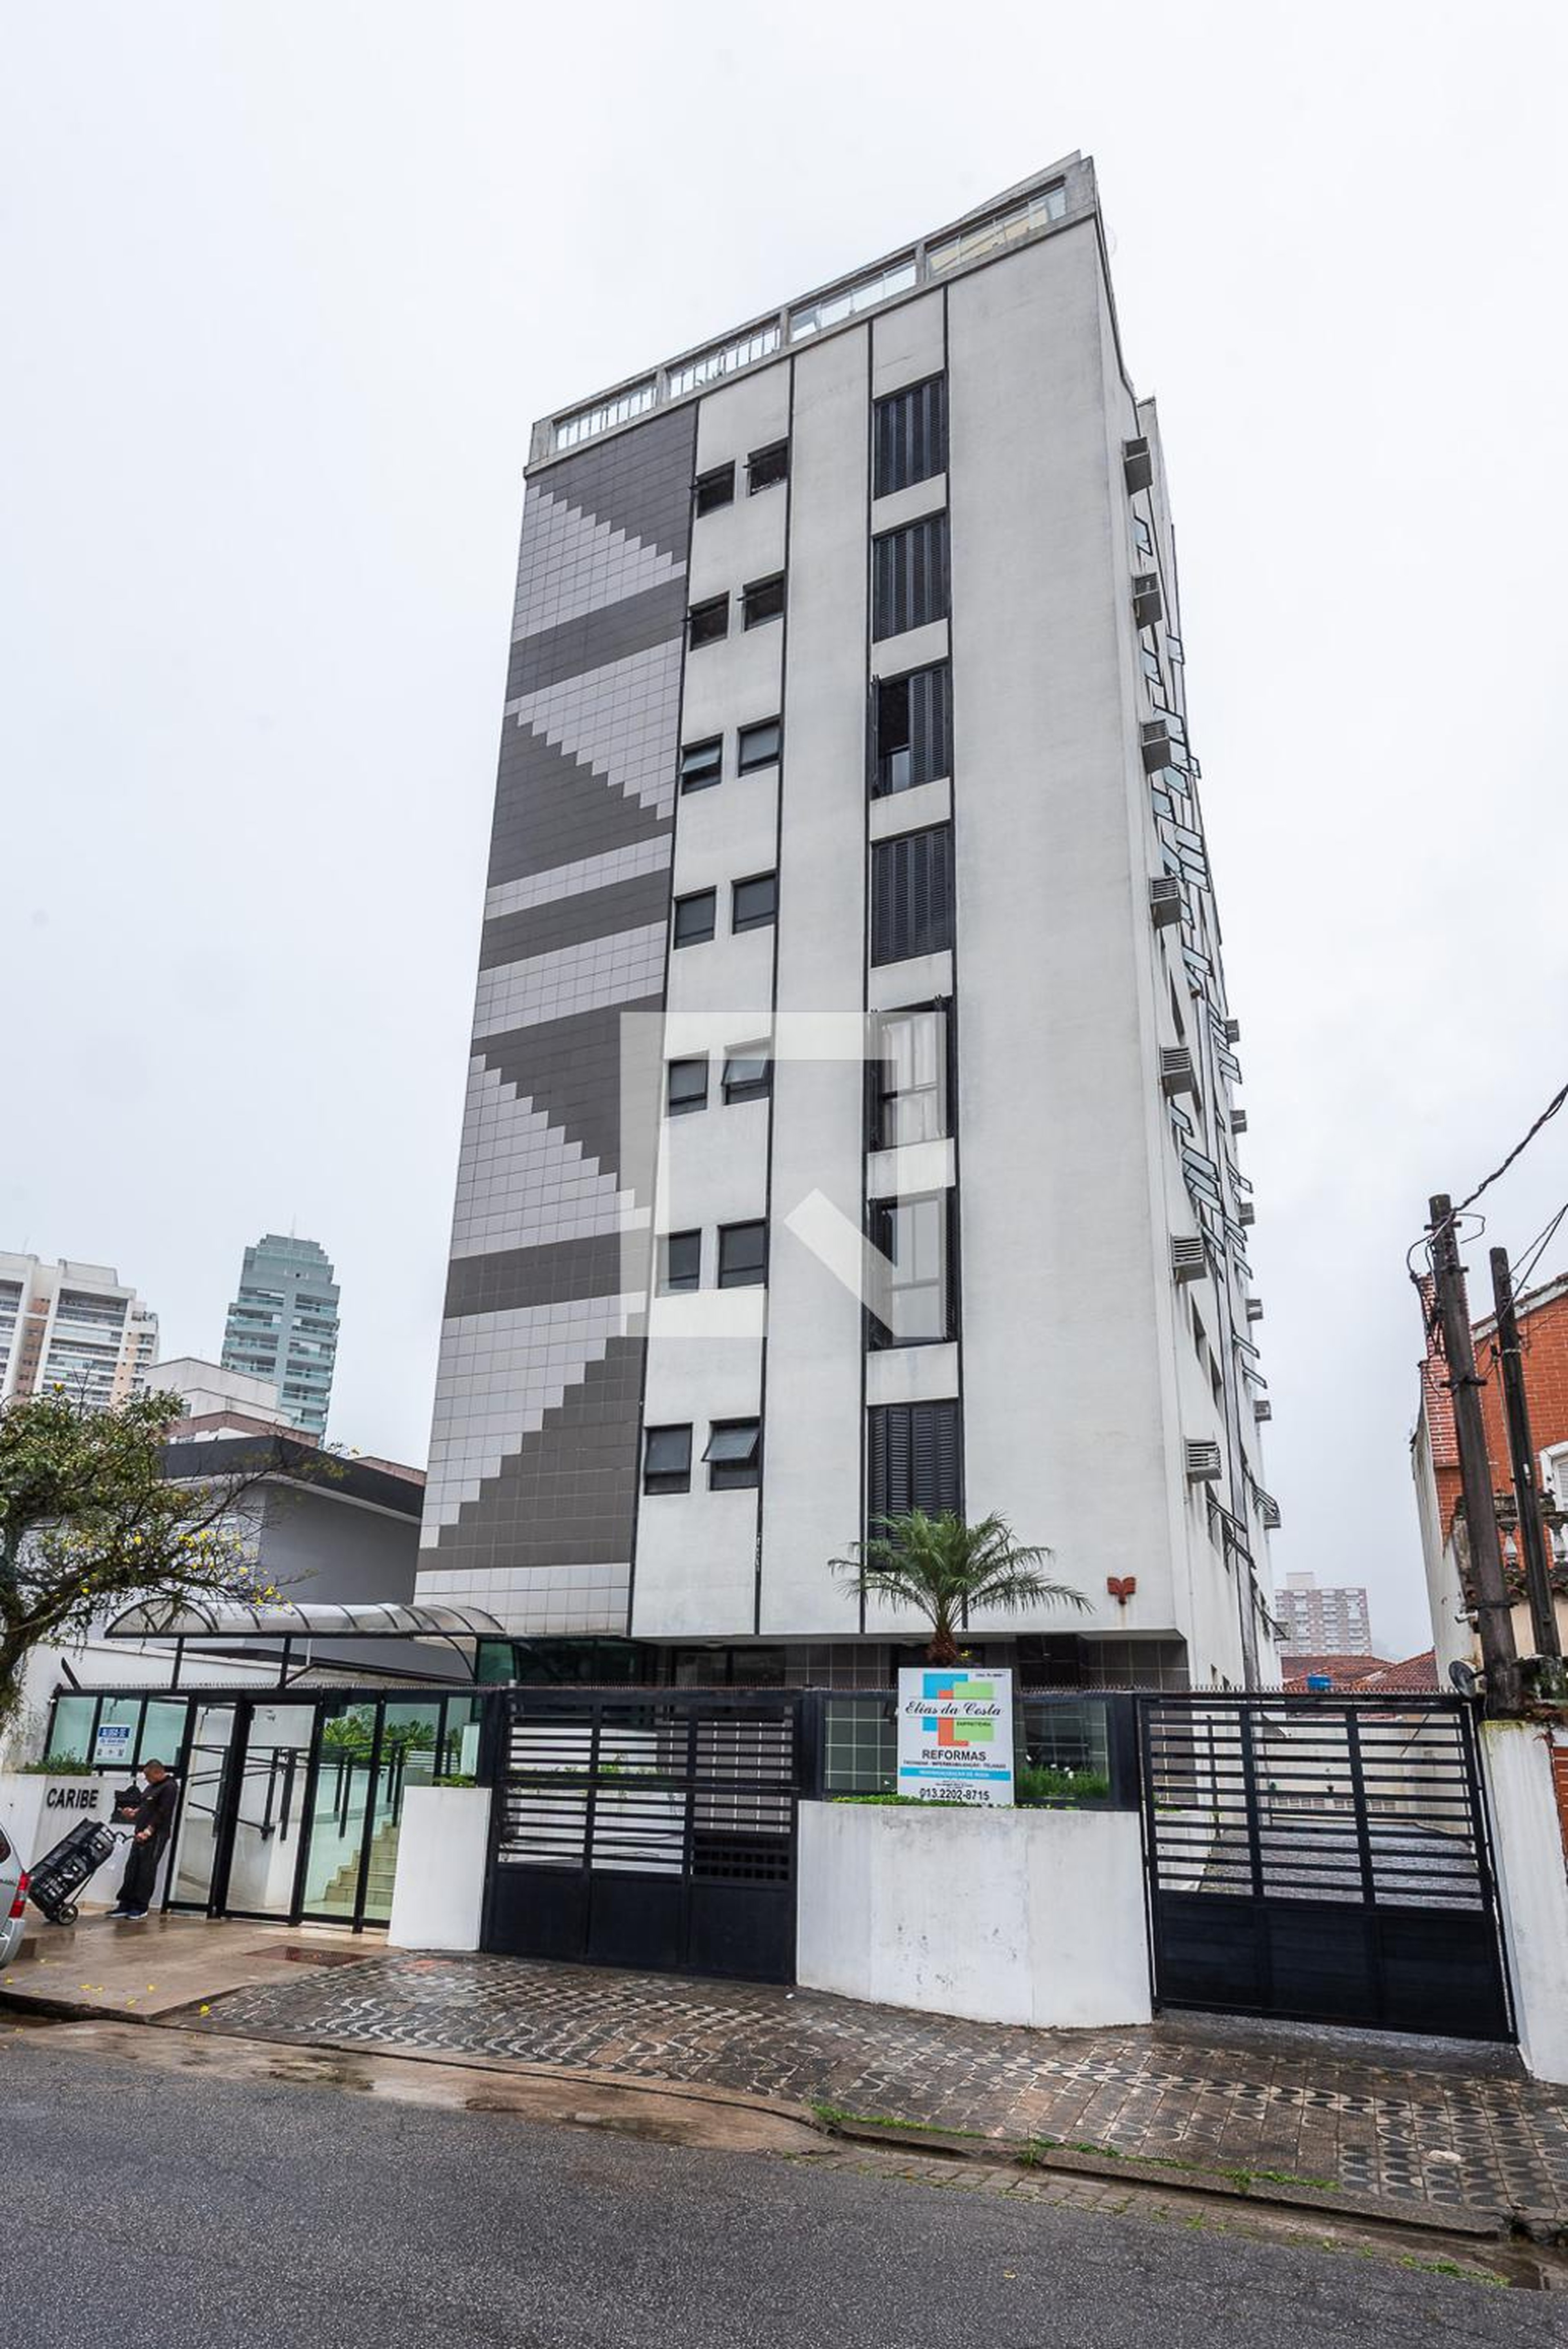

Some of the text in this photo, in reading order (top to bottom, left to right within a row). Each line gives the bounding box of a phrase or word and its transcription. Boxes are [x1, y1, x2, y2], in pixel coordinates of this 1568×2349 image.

[905, 1701, 1002, 1715] Elias da Costa
[922, 1749, 987, 1761] REFORMAS
[47, 1788, 98, 1809] CARIBE
[919, 1788, 990, 1801] 013.2202-8715
